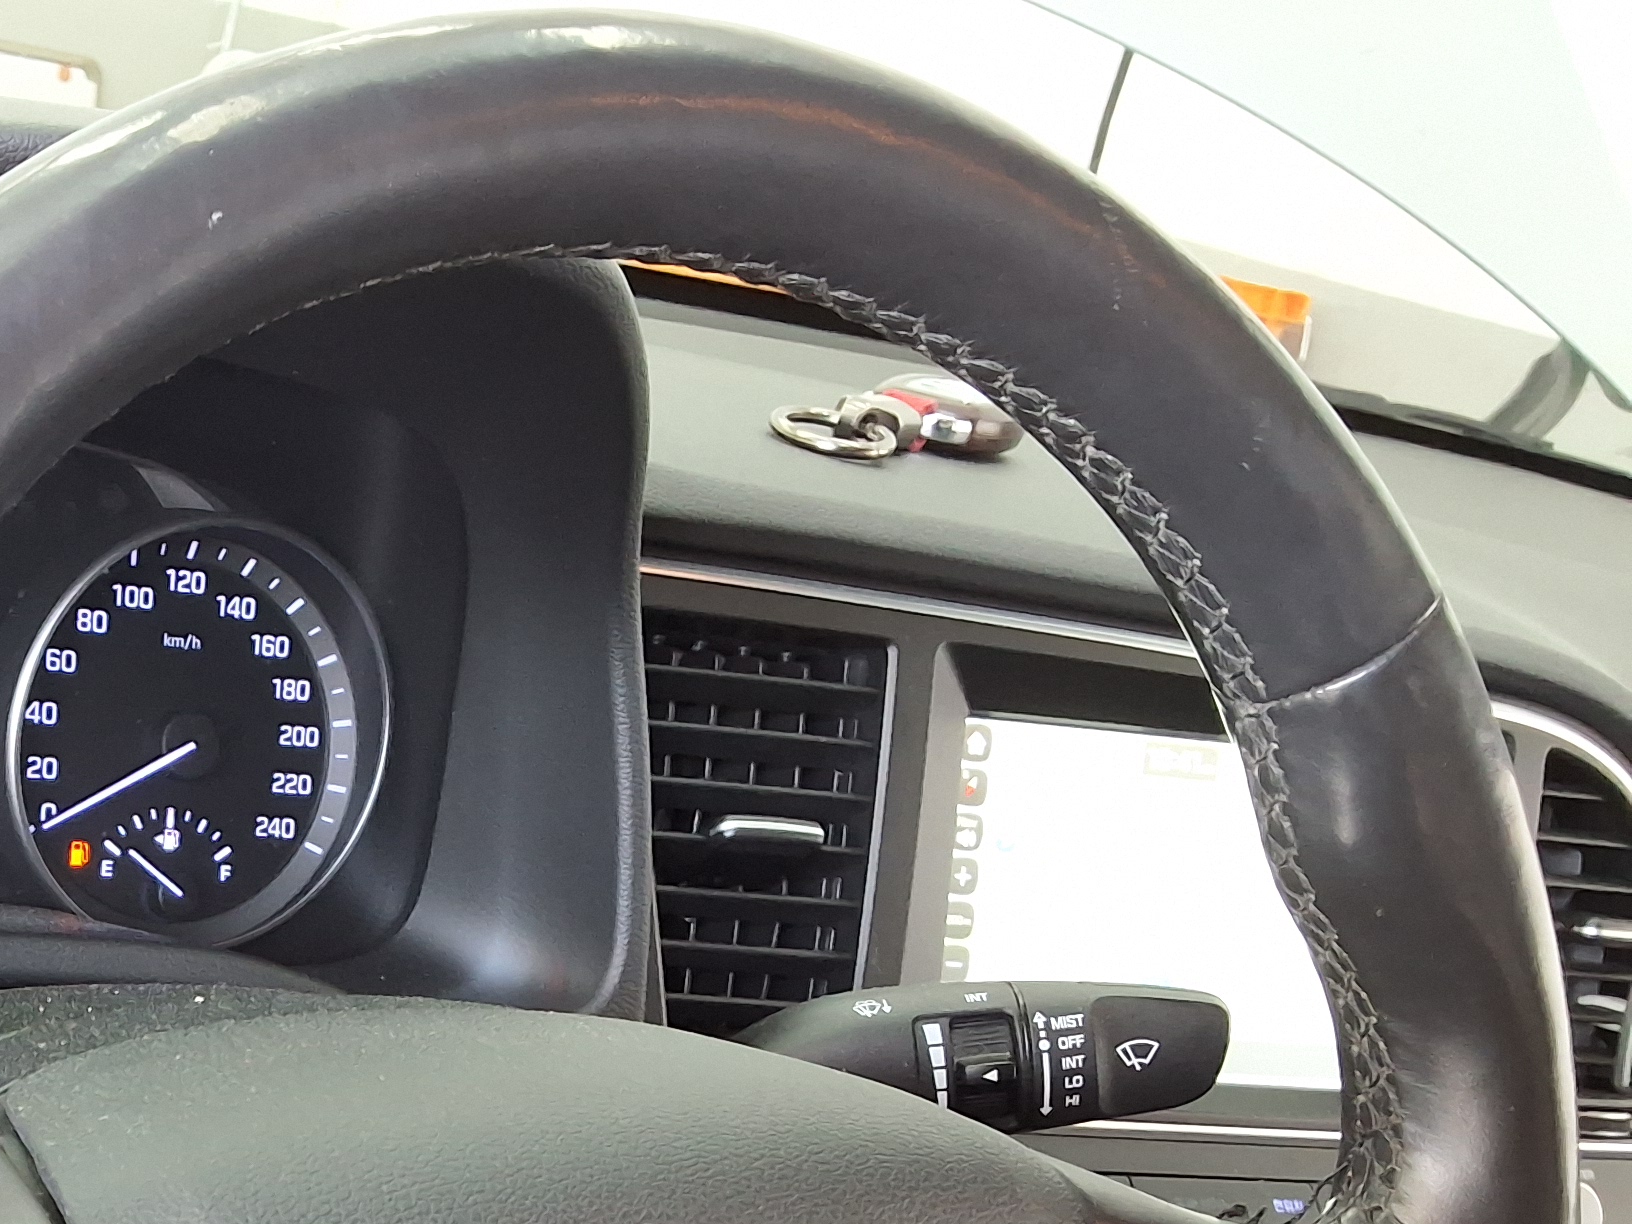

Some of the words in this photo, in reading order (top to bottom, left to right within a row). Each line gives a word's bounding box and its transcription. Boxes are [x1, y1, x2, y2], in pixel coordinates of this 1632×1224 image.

[166, 569, 206, 594] 120
[112, 584, 154, 610] 100
[216, 595, 256, 621] 140
[76, 609, 109, 633] 80
[163, 633, 202, 650] km/h
[251, 634, 290, 658] 160
[45, 649, 77, 674] 60
[272, 678, 311, 702] 180
[24, 701, 58, 725] 40
[278, 725, 319, 748] 200
[26, 756, 58, 780] 20
[272, 773, 312, 795] 220
[255, 816, 295, 840] 240
[100, 860, 115, 878] E
[219, 865, 232, 882] F
[964, 992, 988, 1003] INT
[1051, 1013, 1085, 1030] MIST
[1057, 1034, 1085, 1050] OFF
[1061, 1055, 1085, 1070] INT
[1064, 1075, 1084, 1089] LO
[1065, 1094, 1081, 1107] HI
